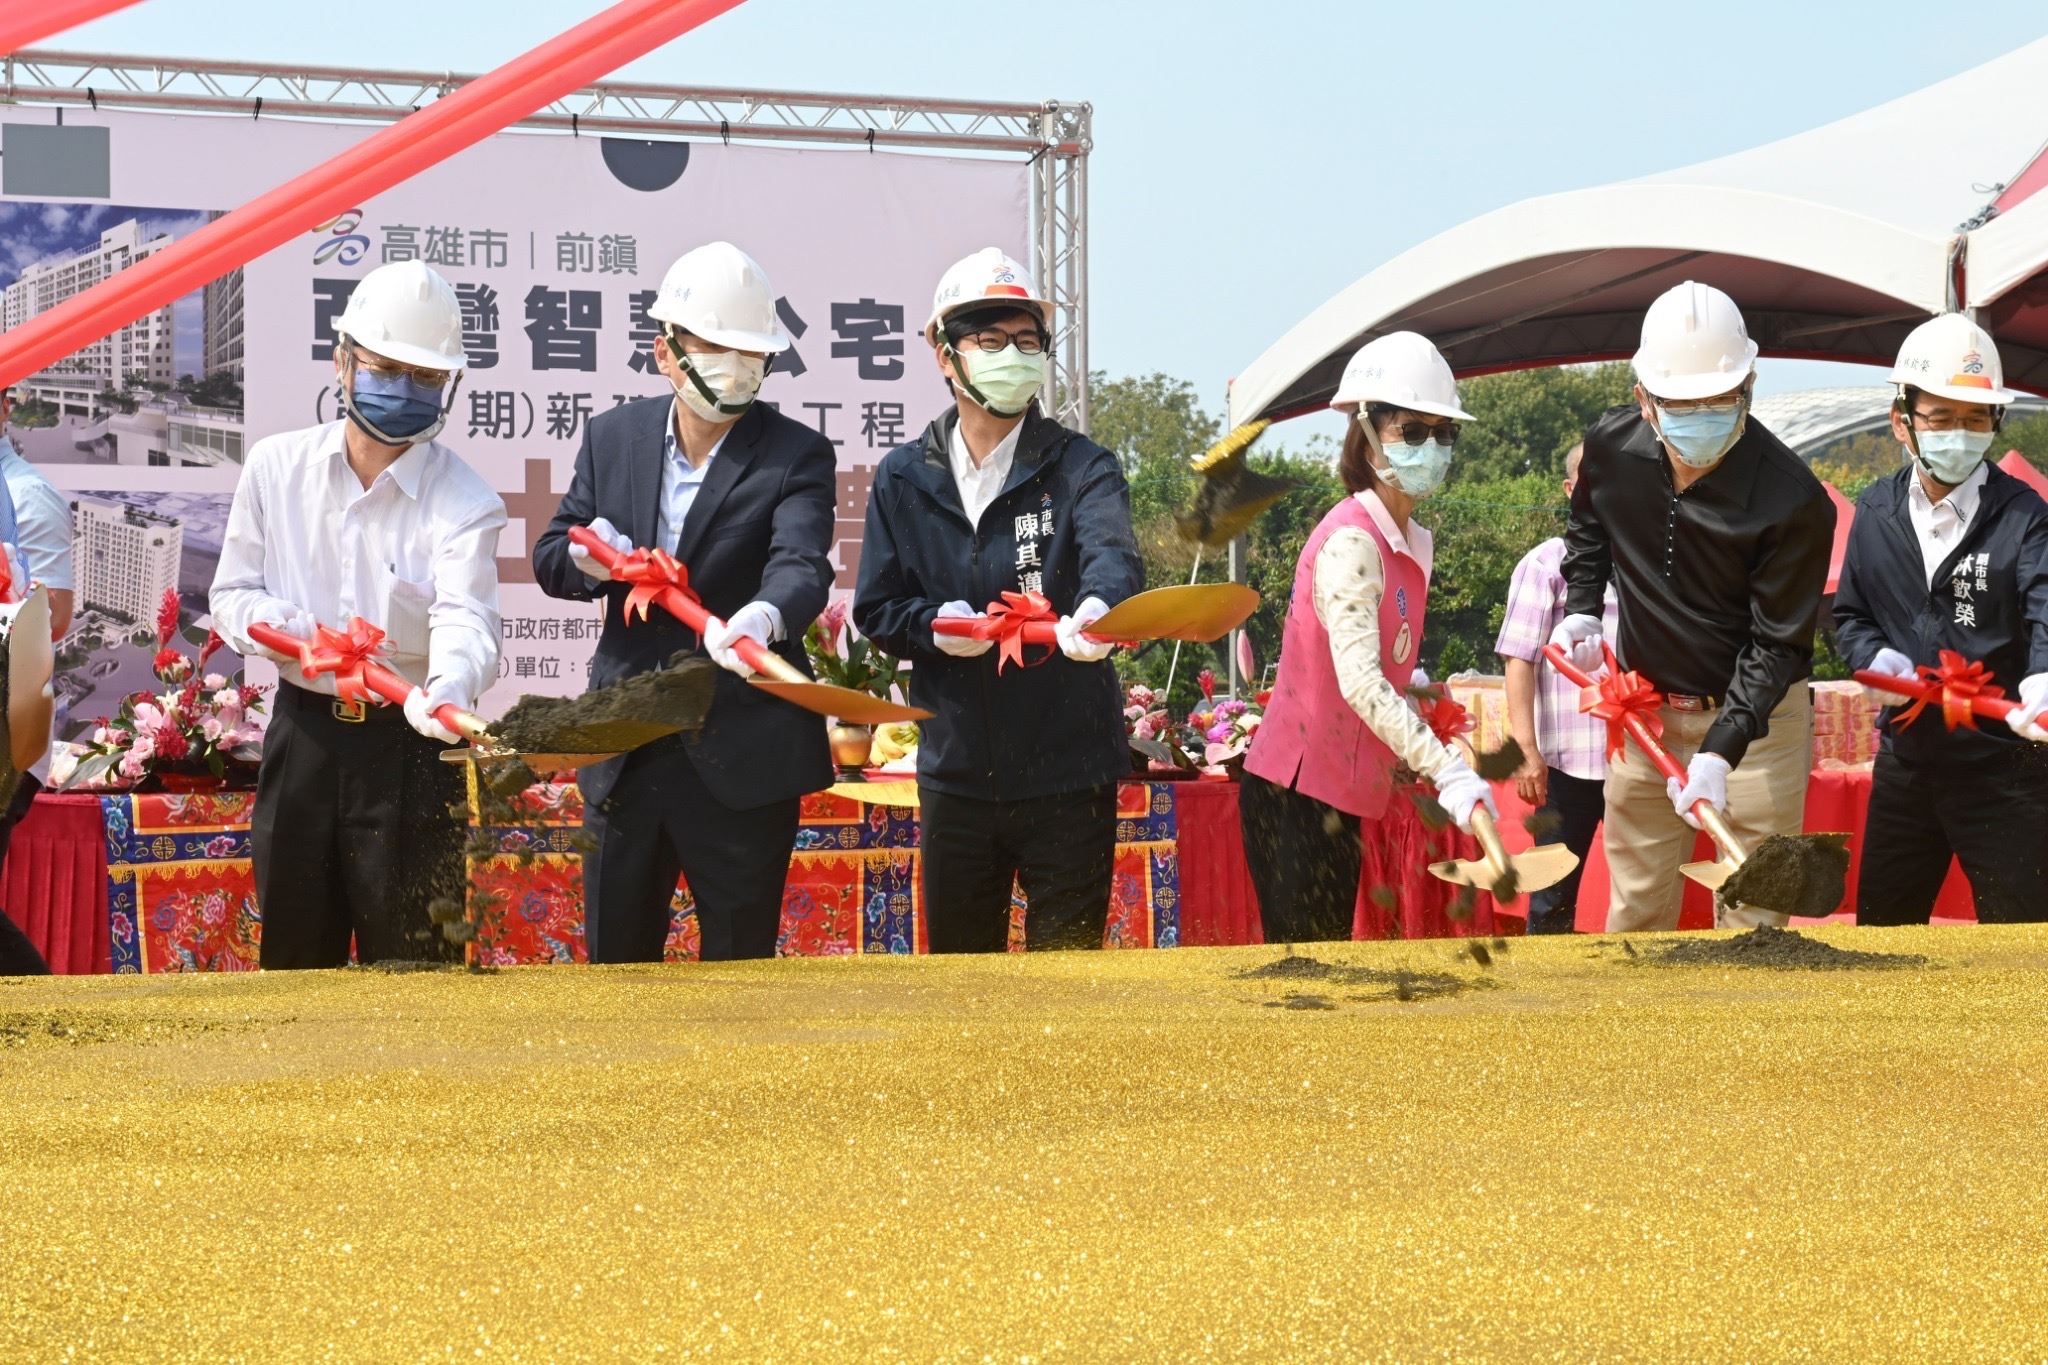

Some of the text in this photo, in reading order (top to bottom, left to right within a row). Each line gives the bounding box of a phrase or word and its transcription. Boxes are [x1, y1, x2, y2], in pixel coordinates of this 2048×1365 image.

[380, 223, 638, 276] 高雄市 前鎮
[1040, 508, 1056, 537] 市長
